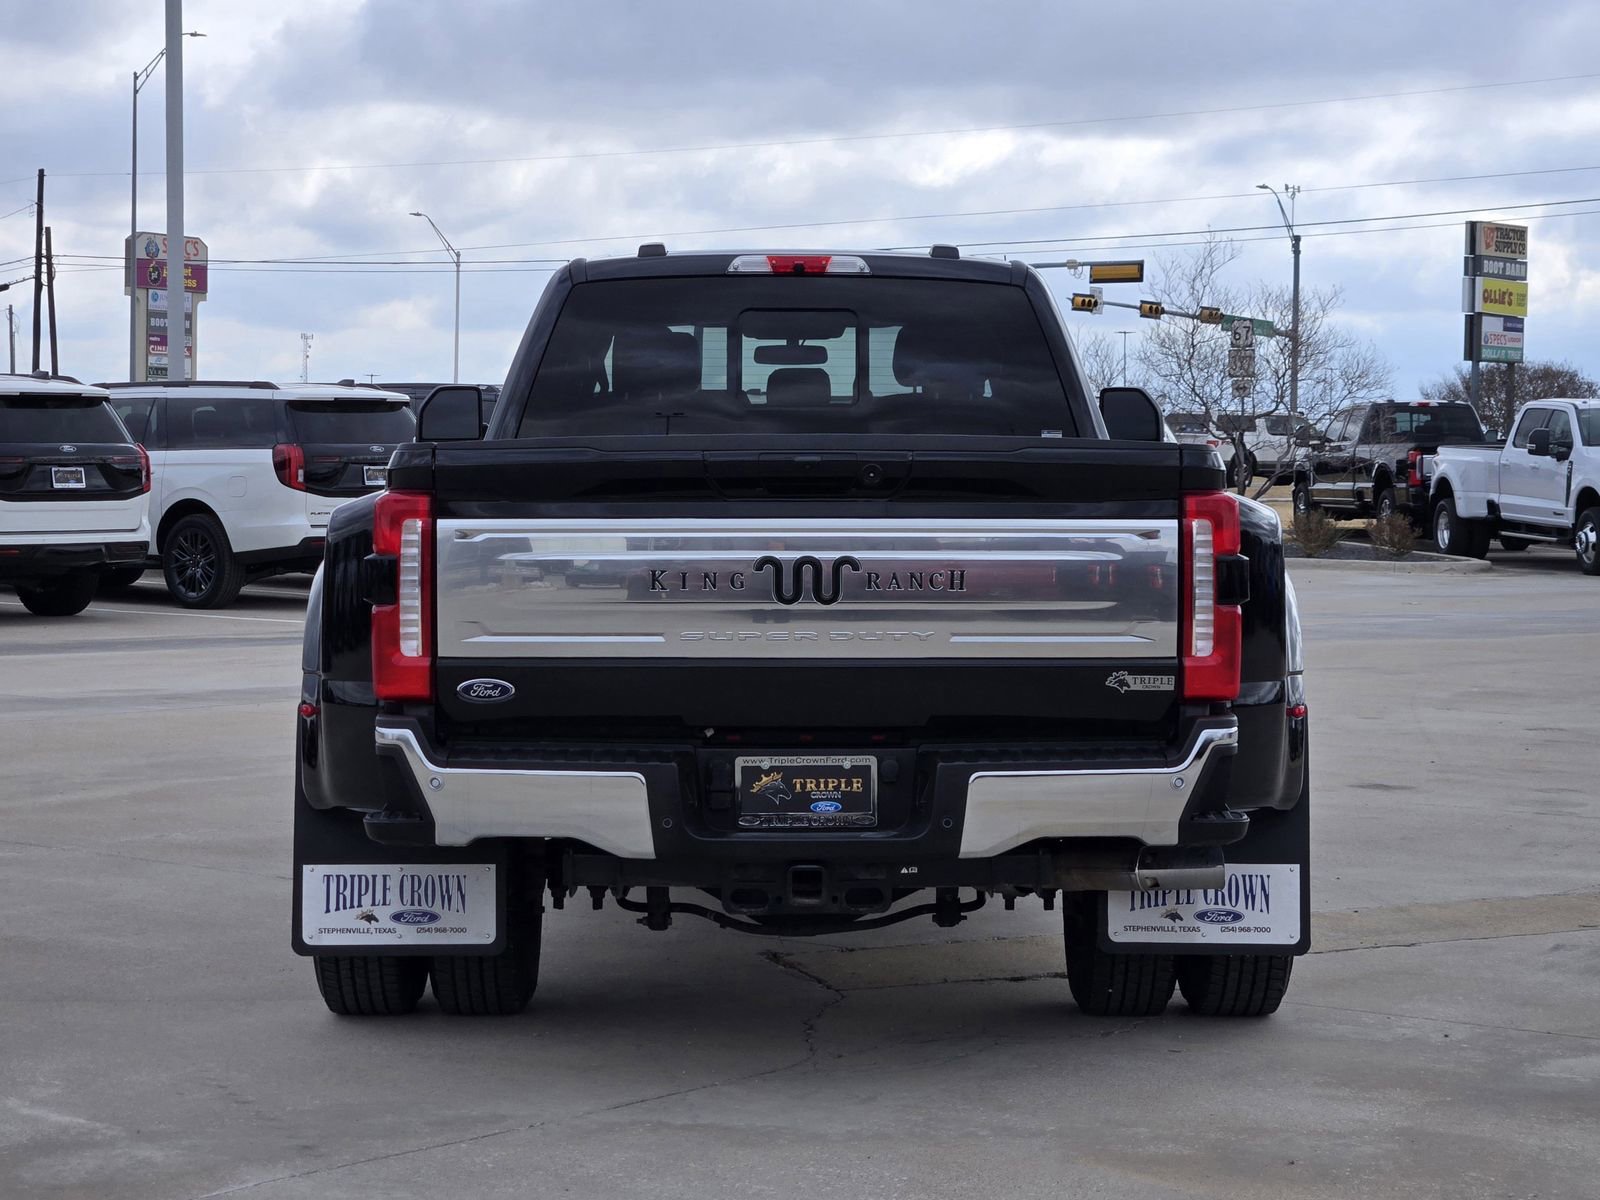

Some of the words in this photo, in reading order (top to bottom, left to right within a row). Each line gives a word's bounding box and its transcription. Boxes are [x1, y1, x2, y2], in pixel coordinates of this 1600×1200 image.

[1495, 227, 1525, 241] TRACTOR
[1494, 240, 1518, 255] SUPPLY
[1483, 260, 1504, 275] BOOT
[1505, 262, 1526, 278] BARN
[1234, 325, 1251, 341] 67
[649, 569, 746, 591] KING
[865, 569, 967, 591] RANCH
[679, 631, 818, 641] SUPER
[829, 631, 935, 641] DUTY
[1132, 677, 1174, 686] TRIPLE
[470, 683, 502, 697] Ford
[742, 757, 871, 765] www.TripleCrownFord.com
[792, 778, 864, 793] TRIPLE
[810, 791, 842, 799] CROWN
[322, 874, 391, 914] TRIPLE
[400, 874, 467, 914] CROWN
[400, 911, 430, 923] Ford
[1204, 911, 1234, 922] Ford
[318, 927, 373, 935] STEPHENVILLE,
[1123, 925, 1178, 933] STEPHENVILLE,
